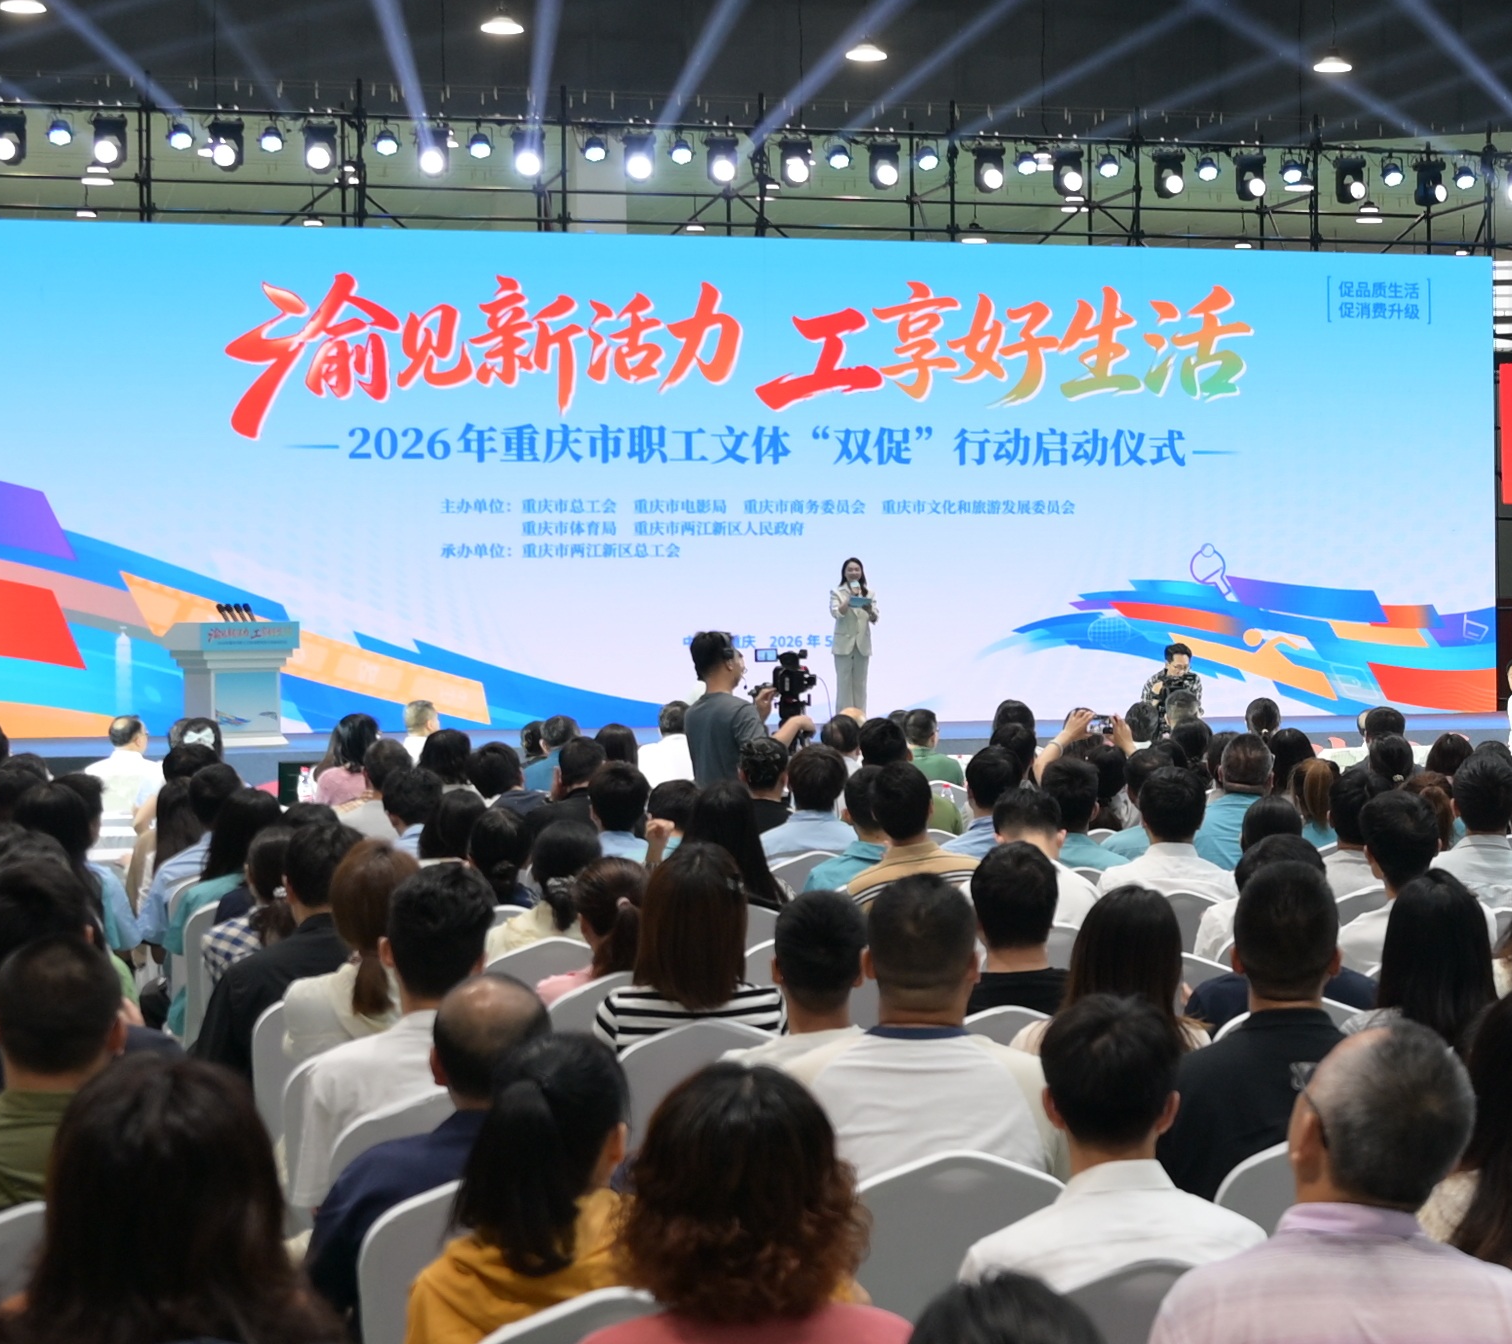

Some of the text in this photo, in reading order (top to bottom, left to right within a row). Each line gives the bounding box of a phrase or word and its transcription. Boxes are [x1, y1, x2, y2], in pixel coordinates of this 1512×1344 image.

[1338, 281, 1420, 299] 促品质生活
[1338, 302, 1420, 320] 促消费升级
[225, 272, 1254, 439] 渝见新活力 工享好生活
[633, 498, 727, 514] 重庆市电影局
[743, 499, 866, 515] 重庆市商务委员会
[882, 499, 1076, 515] 重庆市文化和旅游发展委员会
[521, 520, 805, 537] 重庆市体育局 重庆市两江新区人民政府
[769, 636, 803, 648] 2026
[807, 635, 821, 648] 年
